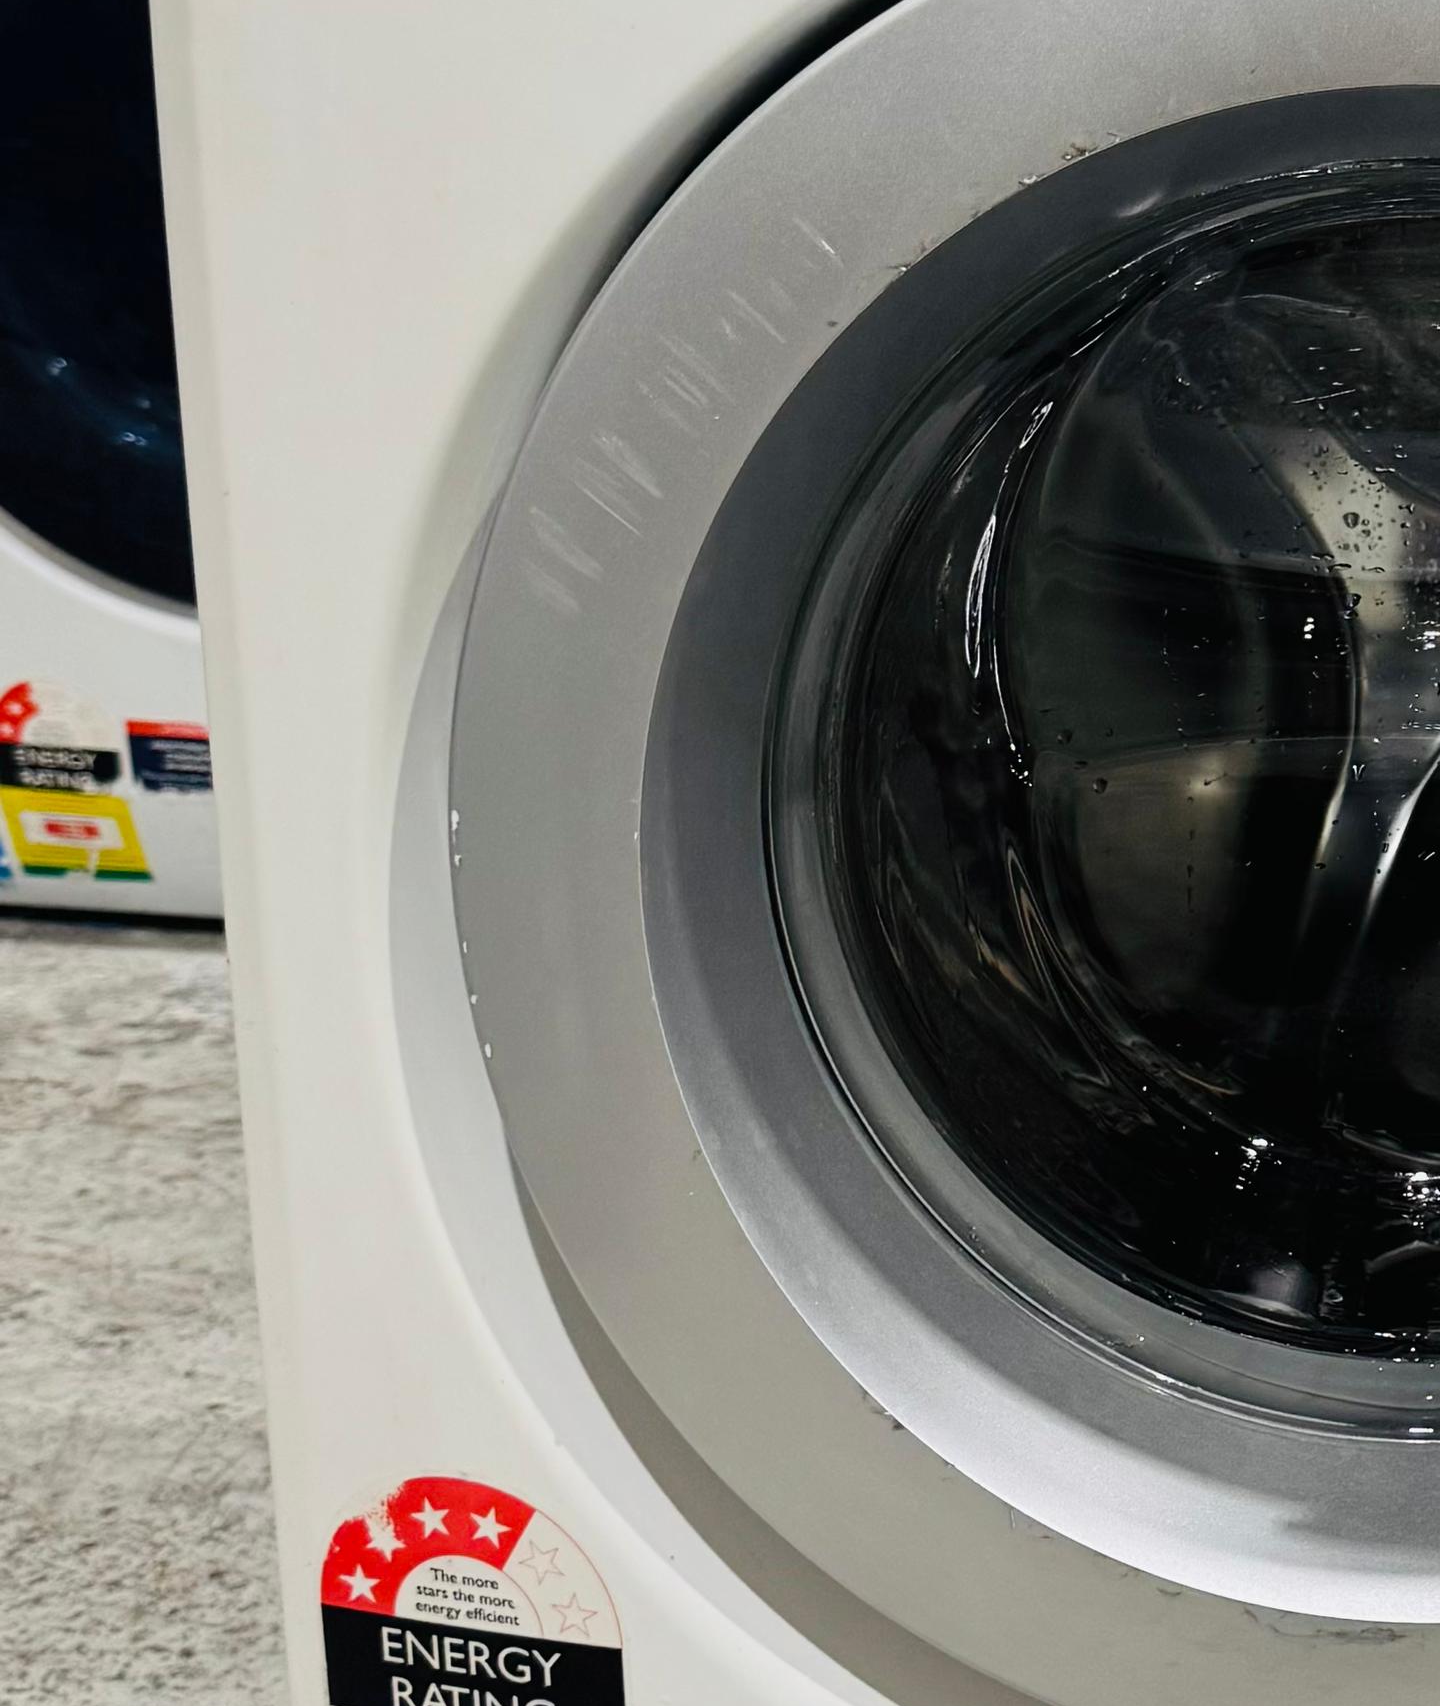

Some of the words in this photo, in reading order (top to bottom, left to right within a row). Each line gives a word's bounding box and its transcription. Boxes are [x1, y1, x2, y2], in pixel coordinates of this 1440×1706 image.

[430, 1567, 458, 1584] The
[462, 1575, 499, 1590] more
[416, 1584, 449, 1600] stars
[452, 1589, 476, 1604] the
[479, 1595, 515, 1609] more
[415, 1601, 461, 1620] energy
[465, 1607, 520, 1627] efficient
[380, 1626, 562, 1688] ENERGY
